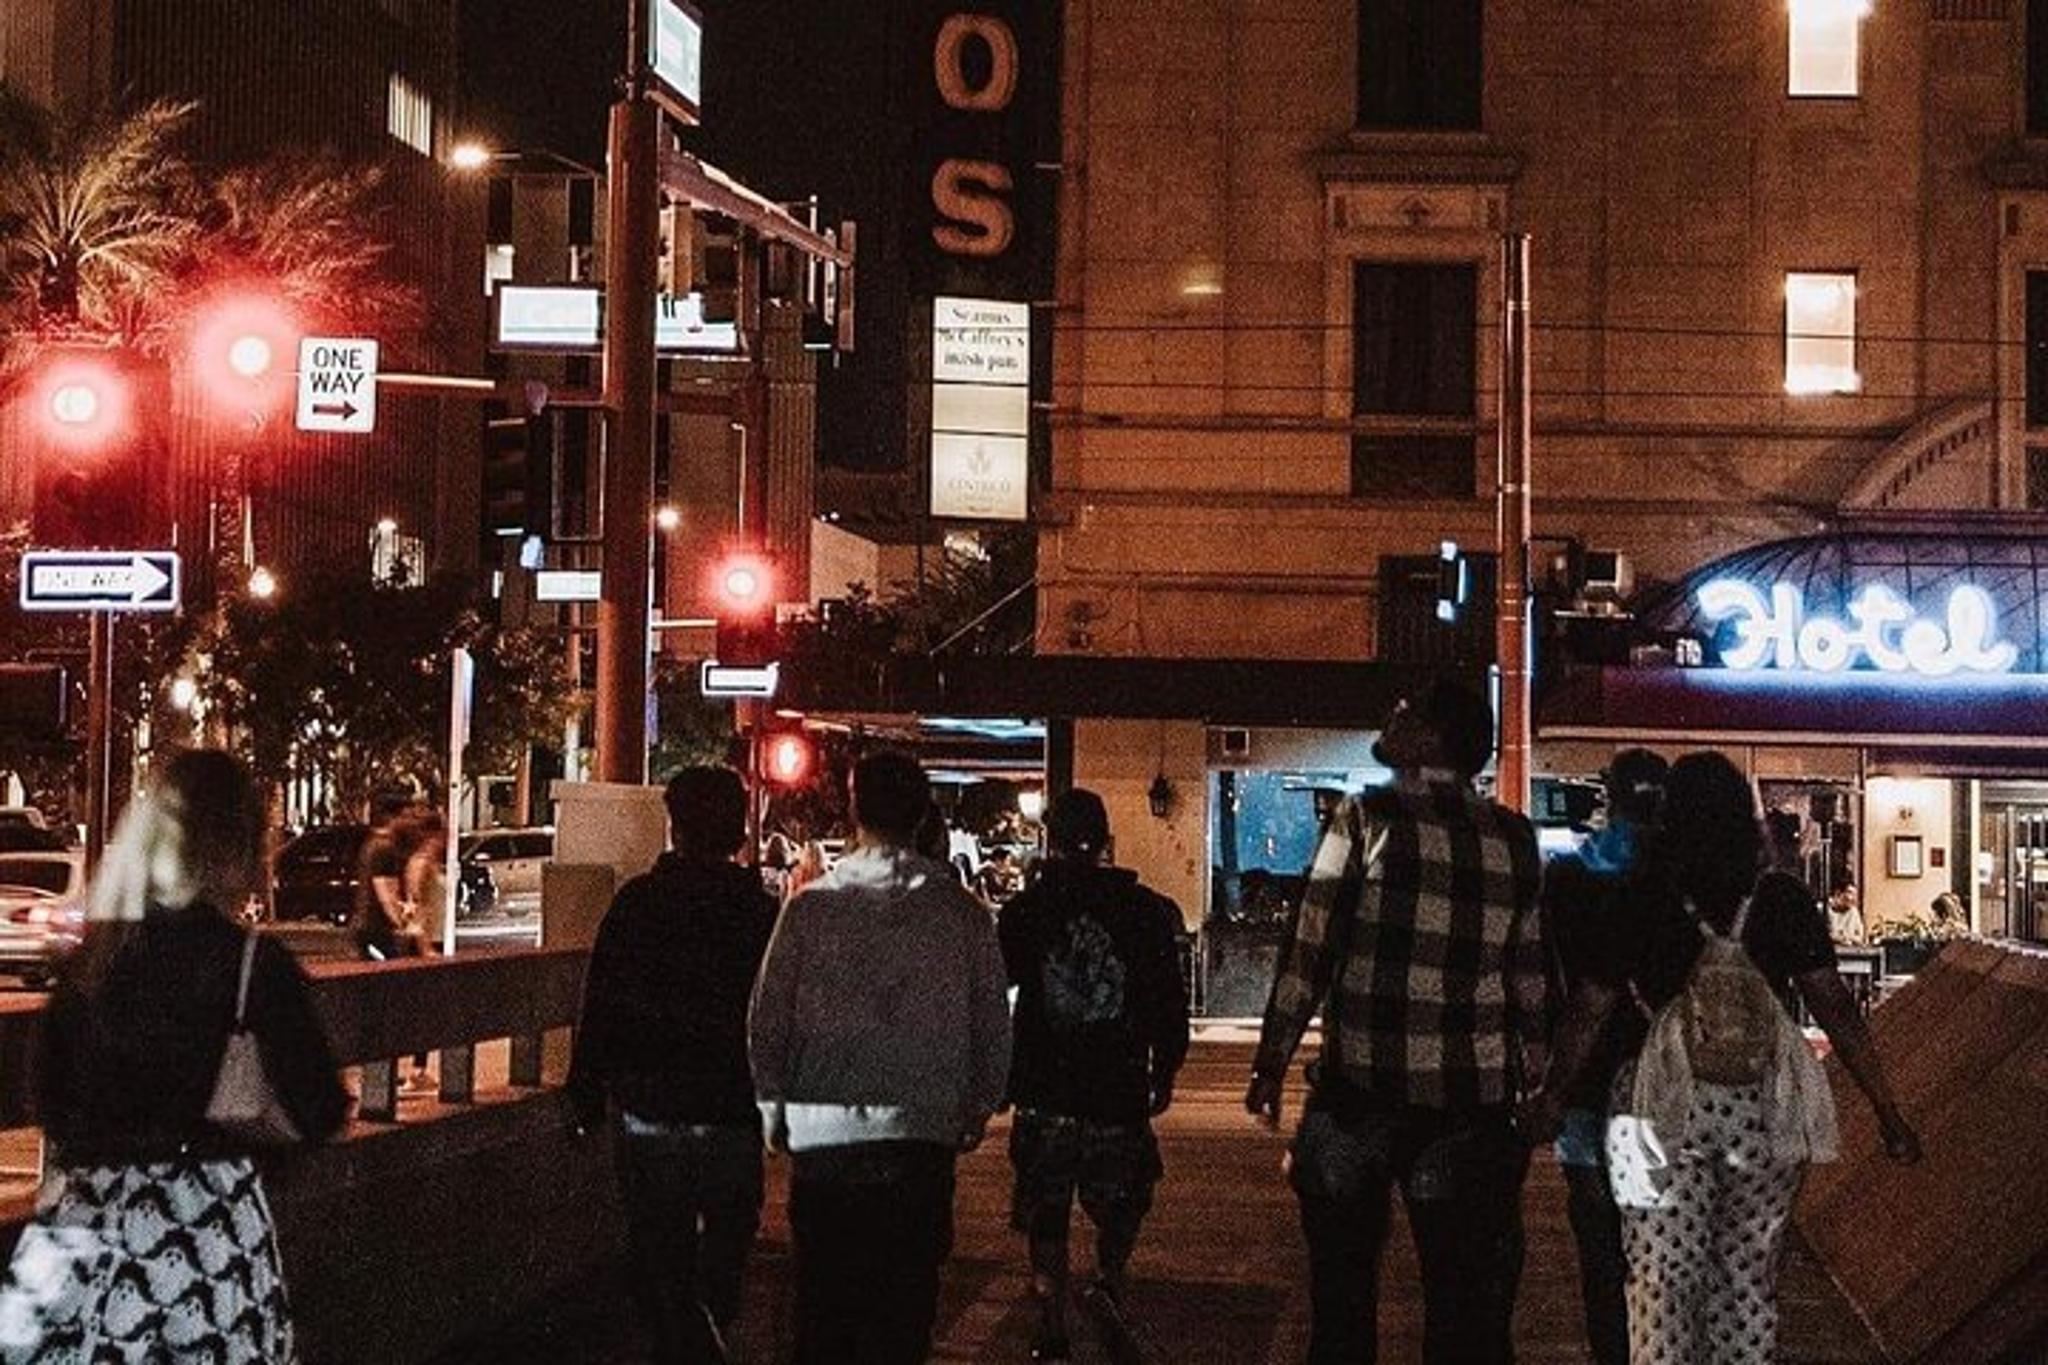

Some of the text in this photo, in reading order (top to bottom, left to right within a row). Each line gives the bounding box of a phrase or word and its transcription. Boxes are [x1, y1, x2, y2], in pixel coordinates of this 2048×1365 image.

[938, 327, 1025, 347] McCaffreys
[312, 346, 363, 370] ONE
[310, 371, 365, 394] WAY
[1697, 578, 2018, 676] Hotel
